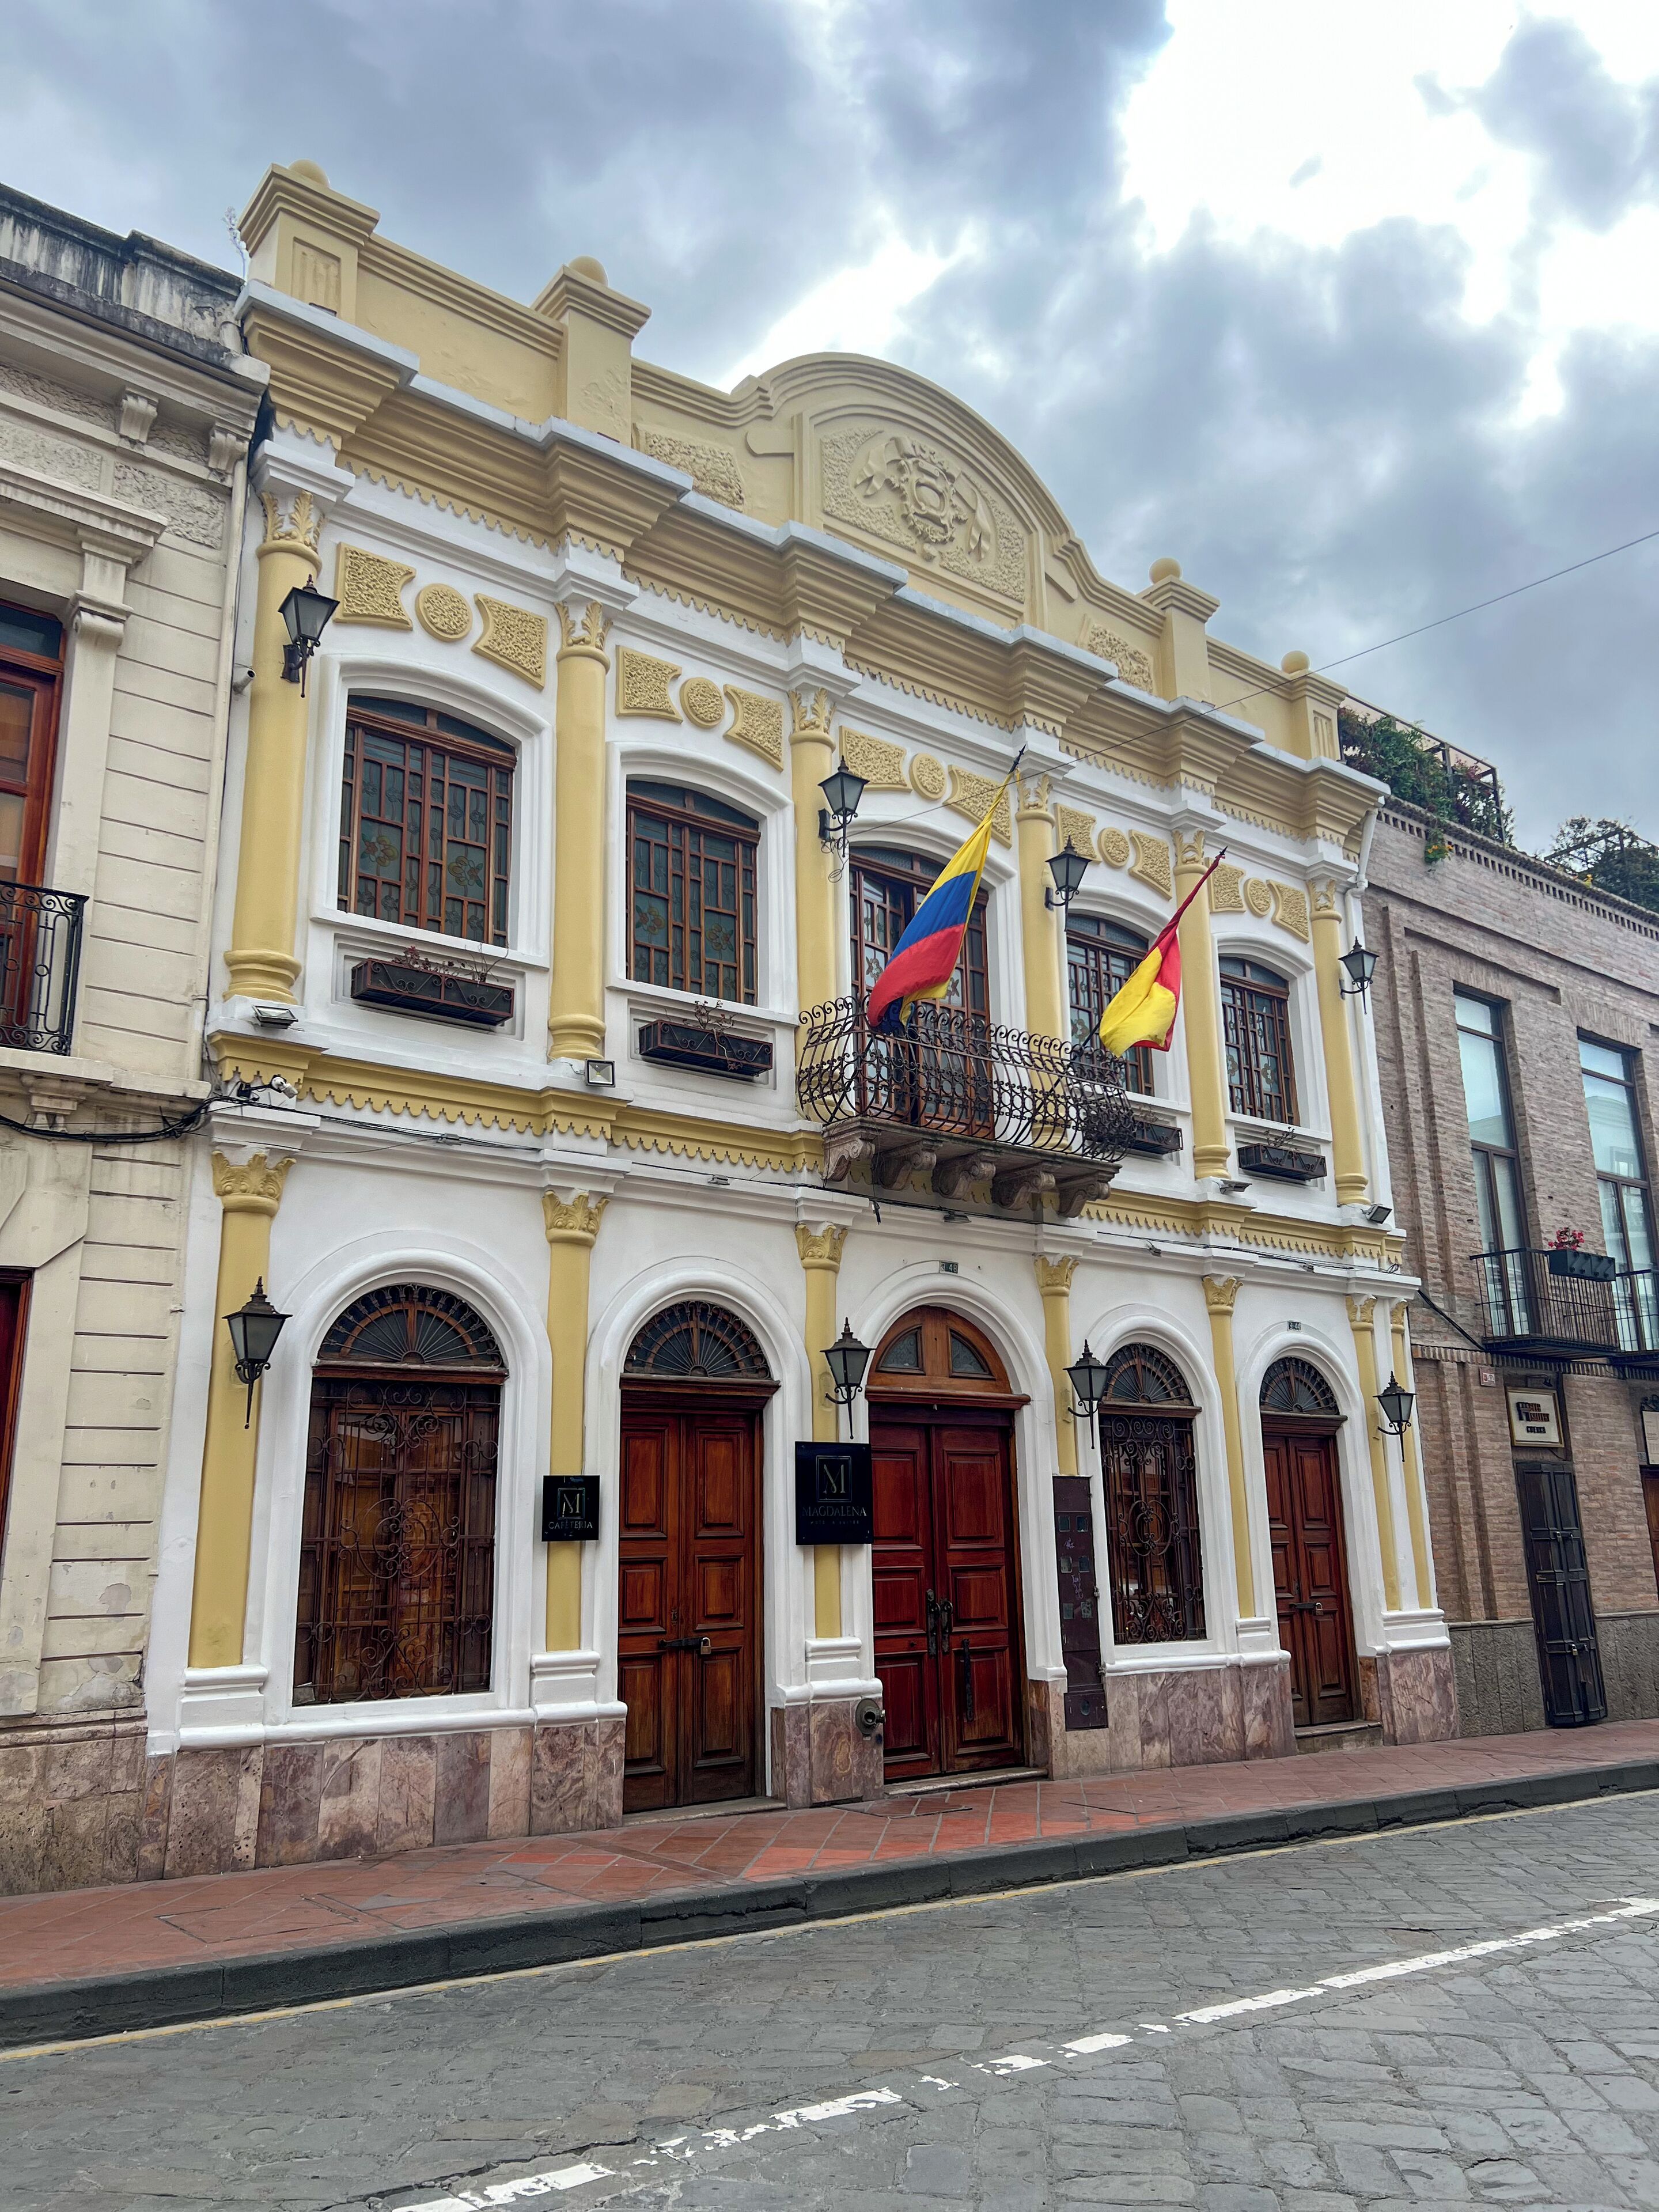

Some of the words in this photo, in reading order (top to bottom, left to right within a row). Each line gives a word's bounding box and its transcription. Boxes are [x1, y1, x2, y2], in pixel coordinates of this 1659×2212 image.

[822, 1464, 846, 1494] M
[561, 1493, 580, 1514] M
[802, 1505, 867, 1517] MAGDALENA
[548, 1521, 593, 1529] CAFETERIA
